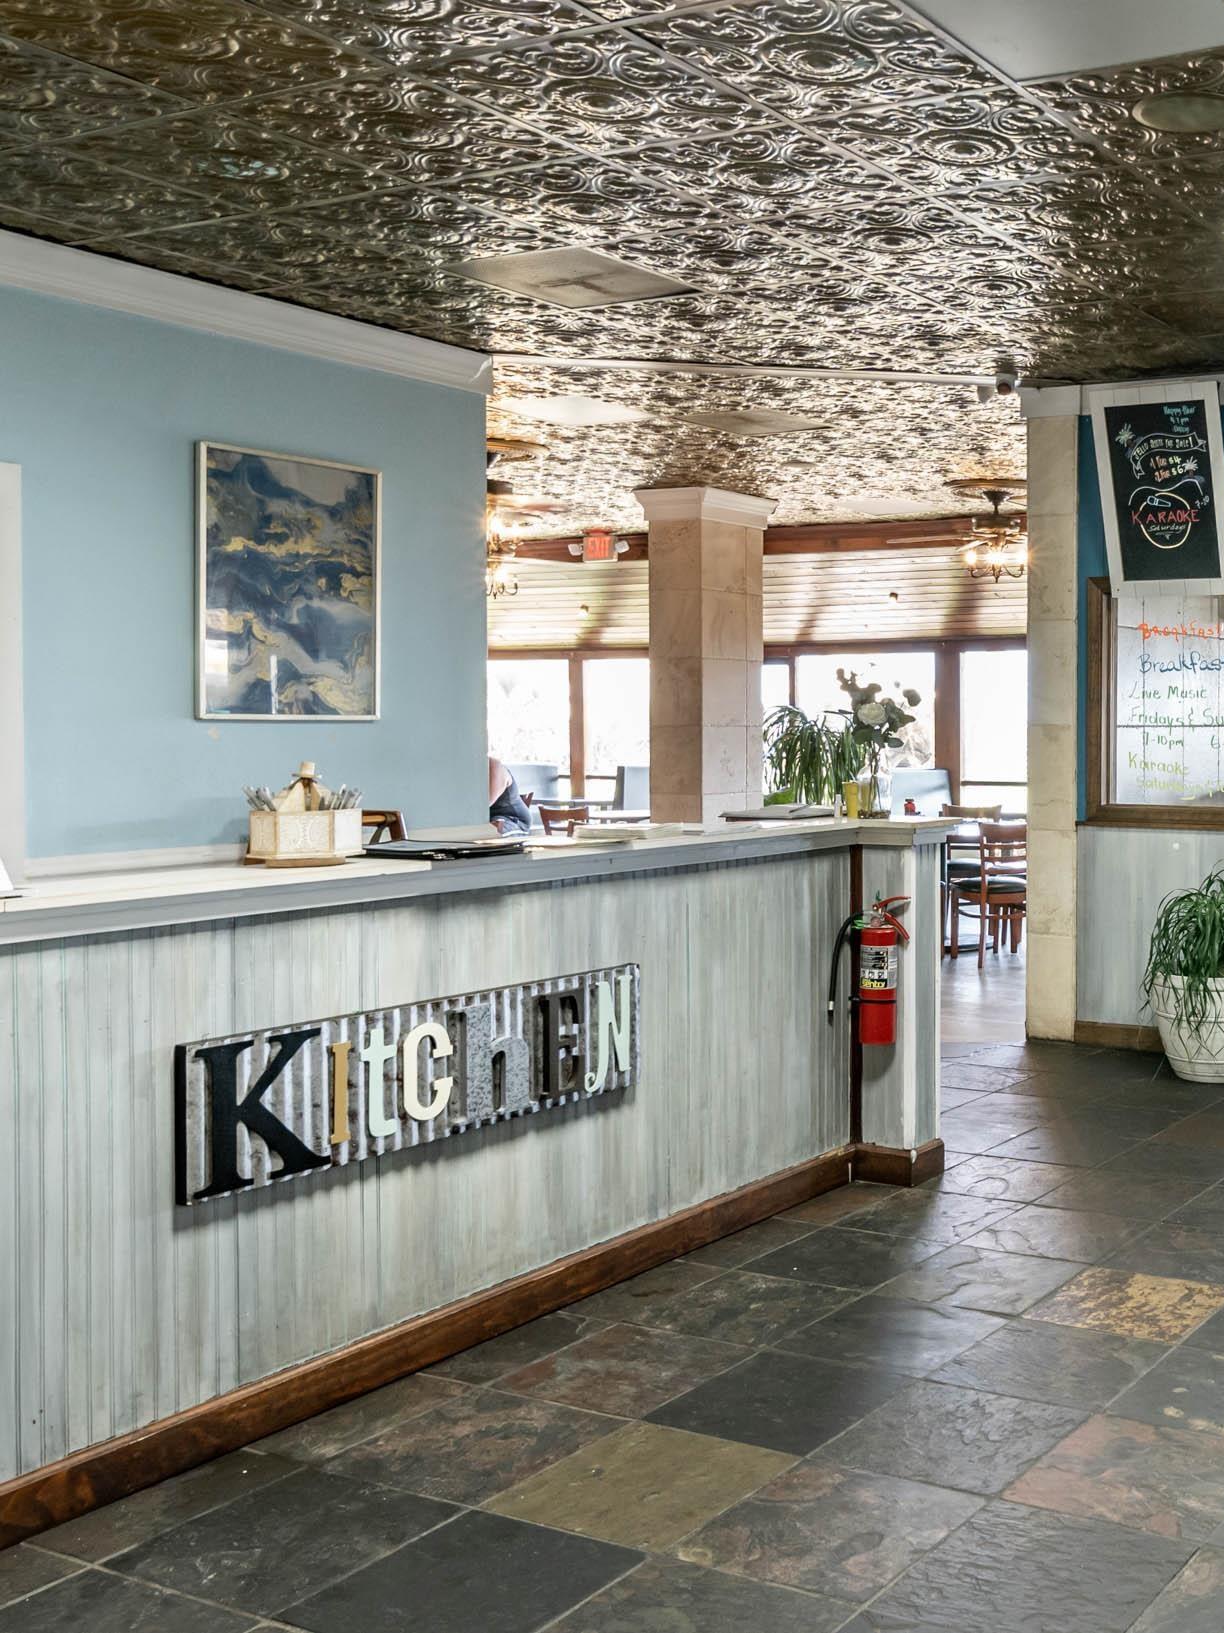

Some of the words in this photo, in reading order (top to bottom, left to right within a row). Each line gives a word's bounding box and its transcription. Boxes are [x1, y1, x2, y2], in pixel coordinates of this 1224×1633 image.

[1131, 509, 1201, 525] KARAOKE
[588, 537, 609, 559] EXIT
[1167, 685, 1207, 700] Music
[1128, 705, 1184, 736] Fridays
[1128, 751, 1190, 776] Karaoke
